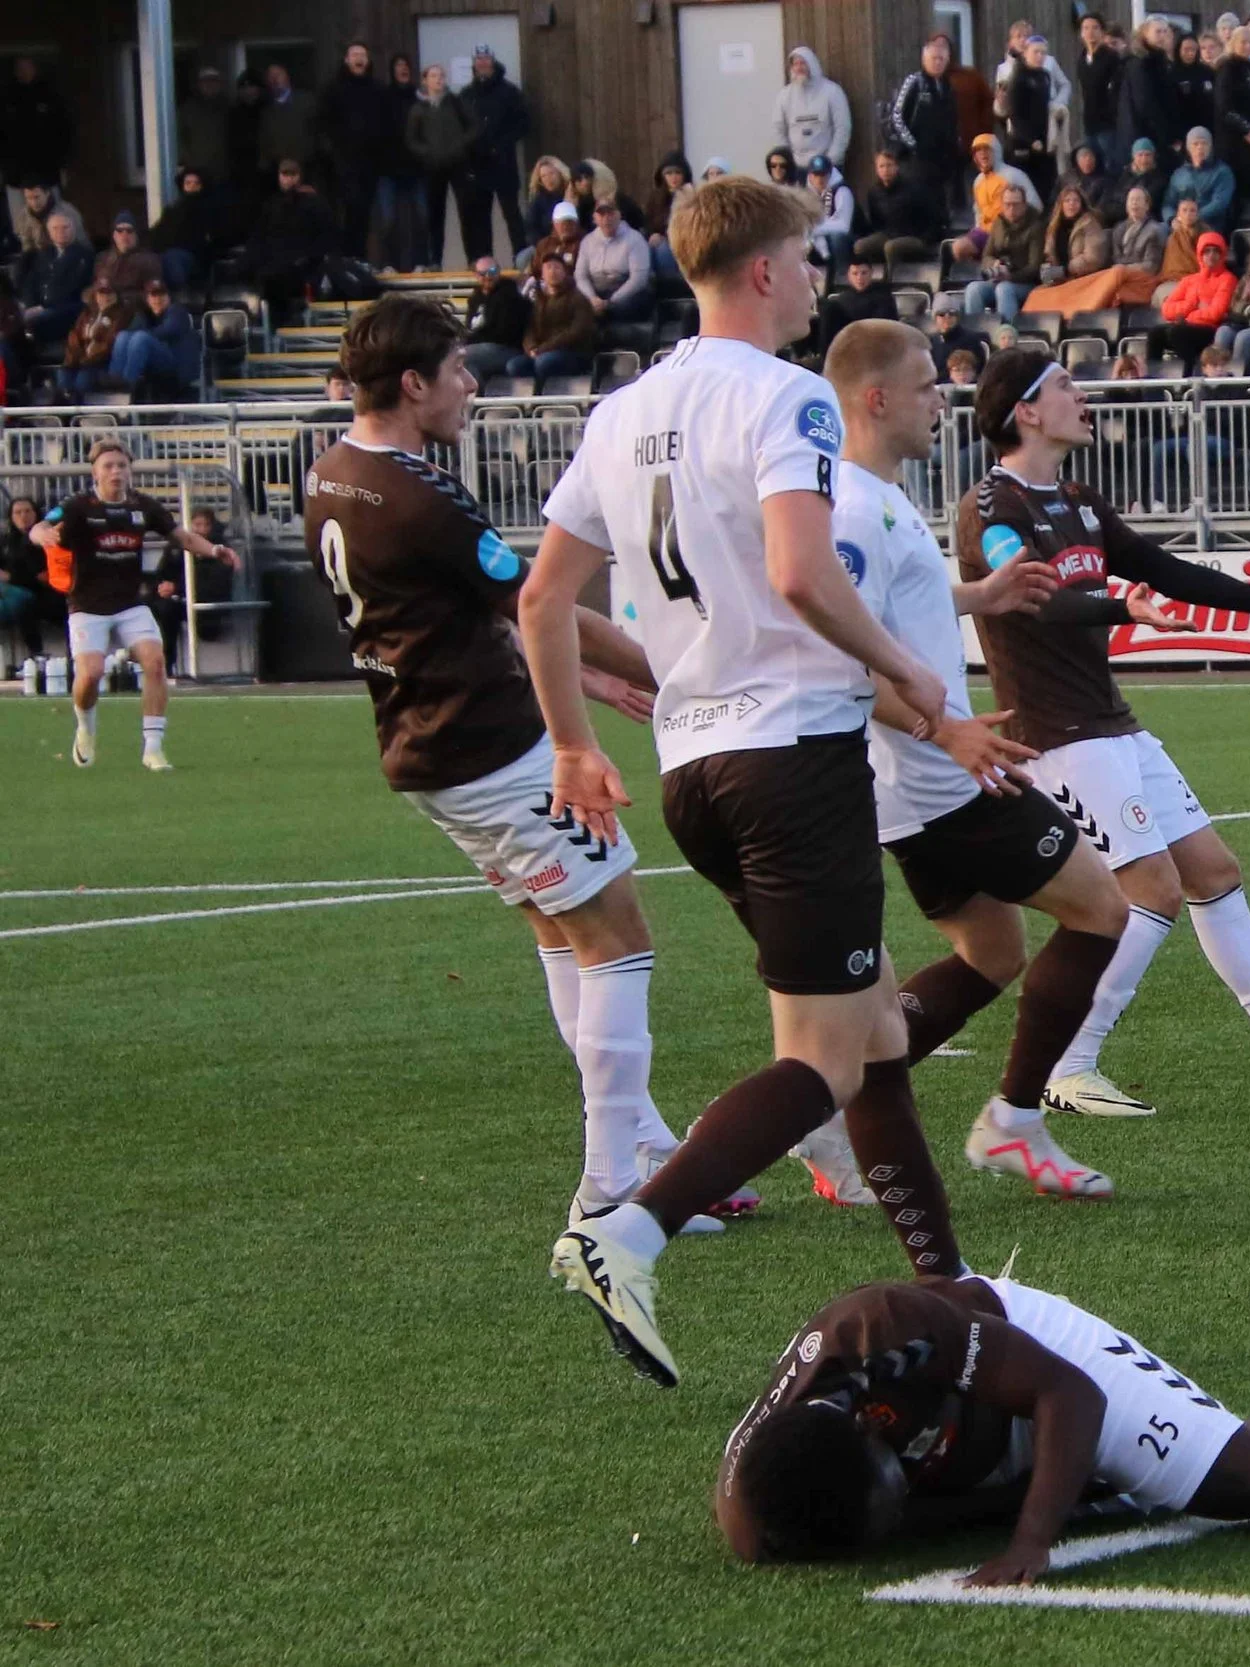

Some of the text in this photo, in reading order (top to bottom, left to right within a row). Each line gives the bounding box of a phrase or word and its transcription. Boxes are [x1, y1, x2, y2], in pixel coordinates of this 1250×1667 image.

[807, 427, 839, 446] OBO
[649, 471, 709, 621] 4
[320, 518, 364, 629] 9
[661, 703, 729, 733] Rett Fram
[1138, 1414, 1179, 1461] 25
